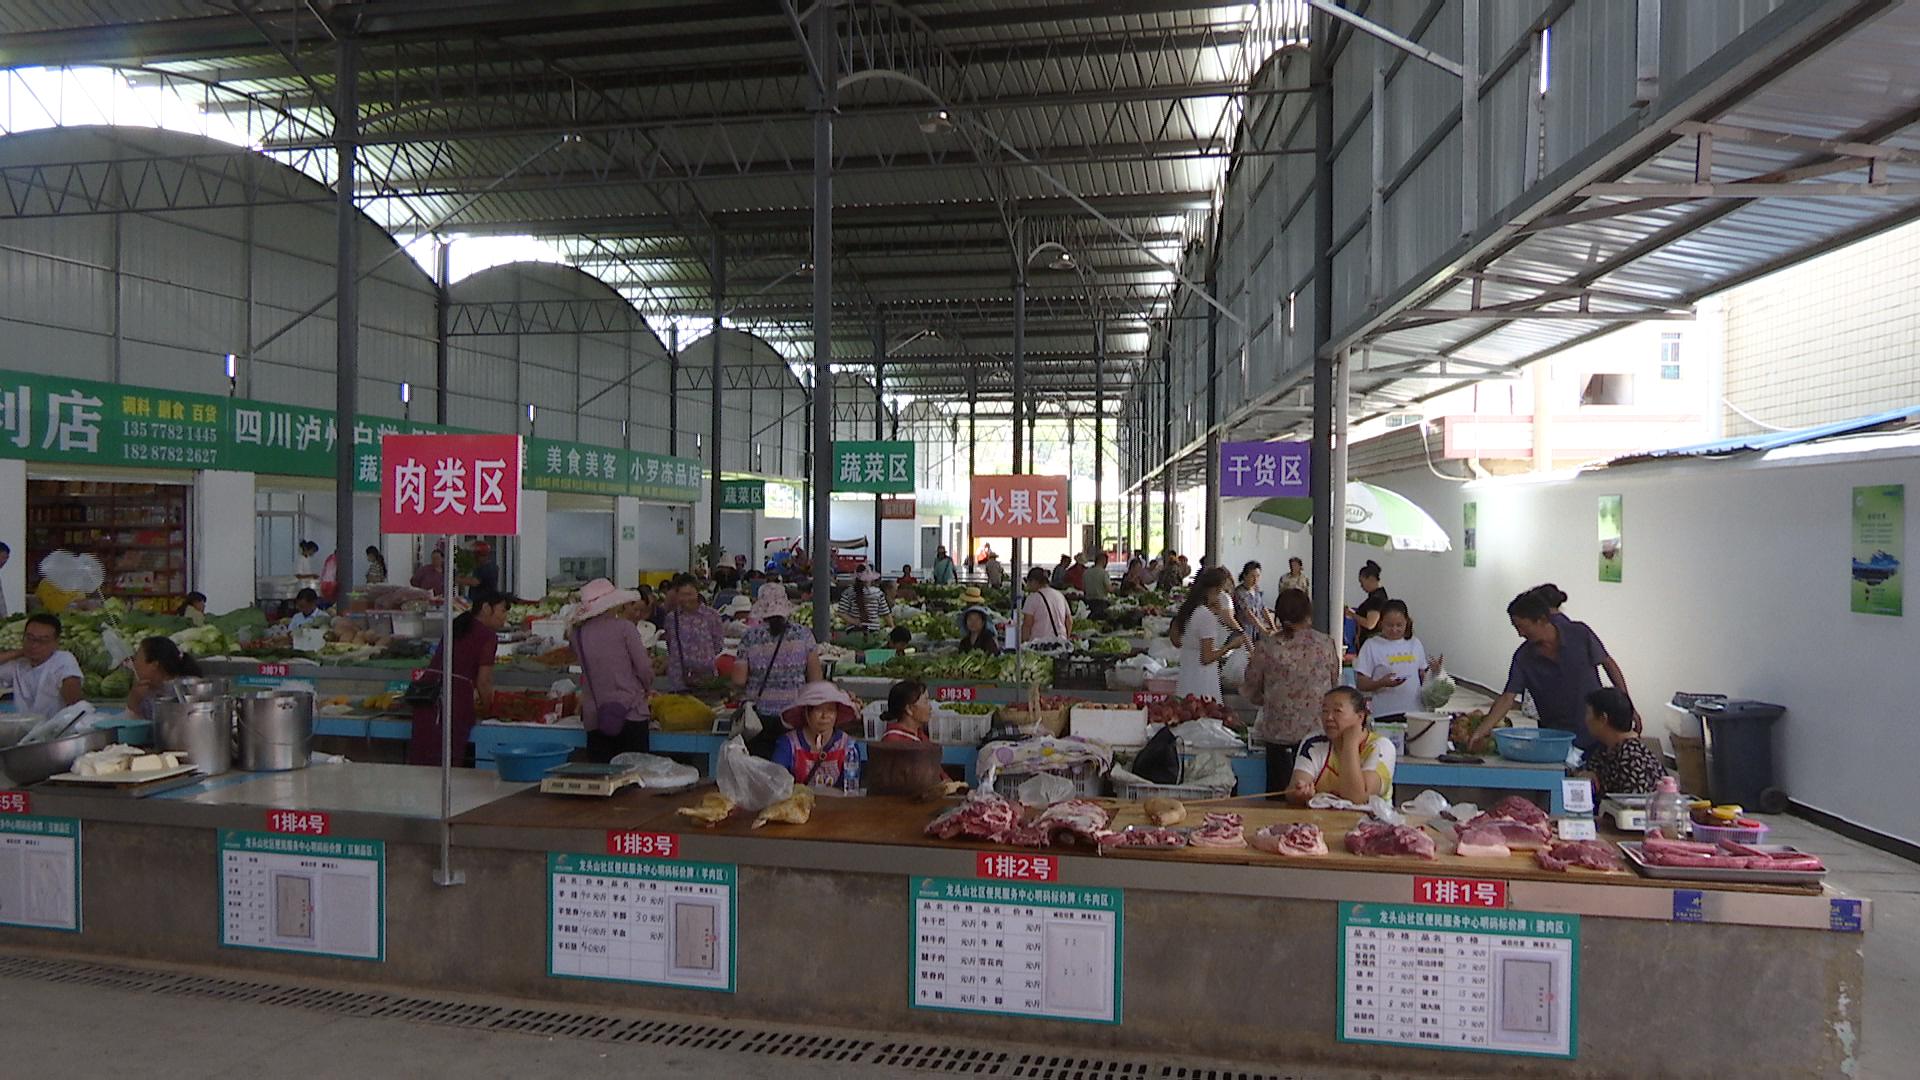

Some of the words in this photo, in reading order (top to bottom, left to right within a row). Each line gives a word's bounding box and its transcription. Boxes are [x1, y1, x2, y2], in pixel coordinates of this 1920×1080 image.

[122, 396, 150, 417] 调料
[158, 401, 184, 420] 副食
[192, 404, 217, 422] 百货
[123, 421, 148, 437] 135
[151, 423, 184, 439] 7782
[187, 426, 217, 443] 1445
[123, 444, 148, 459] 182
[151, 446, 183, 462] 8782
[187, 448, 217, 464] 2627
[547, 445, 616, 480] 美食美客
[840, 452, 908, 482] 蔬菜区
[630, 457, 701, 488] 小罗冻品店
[1228, 454, 1302, 487] 干货区
[395, 458, 507, 515] 肉类区
[725, 486, 762, 505] 蔬菜区
[981, 488, 1060, 525] 水果区
[0, 794, 25, 813] 5号
[272, 812, 325, 834] 1排4号
[613, 833, 673, 856] 1排3号
[984, 855, 1051, 880] 1排2号
[1422, 879, 1498, 906] 1排1号
